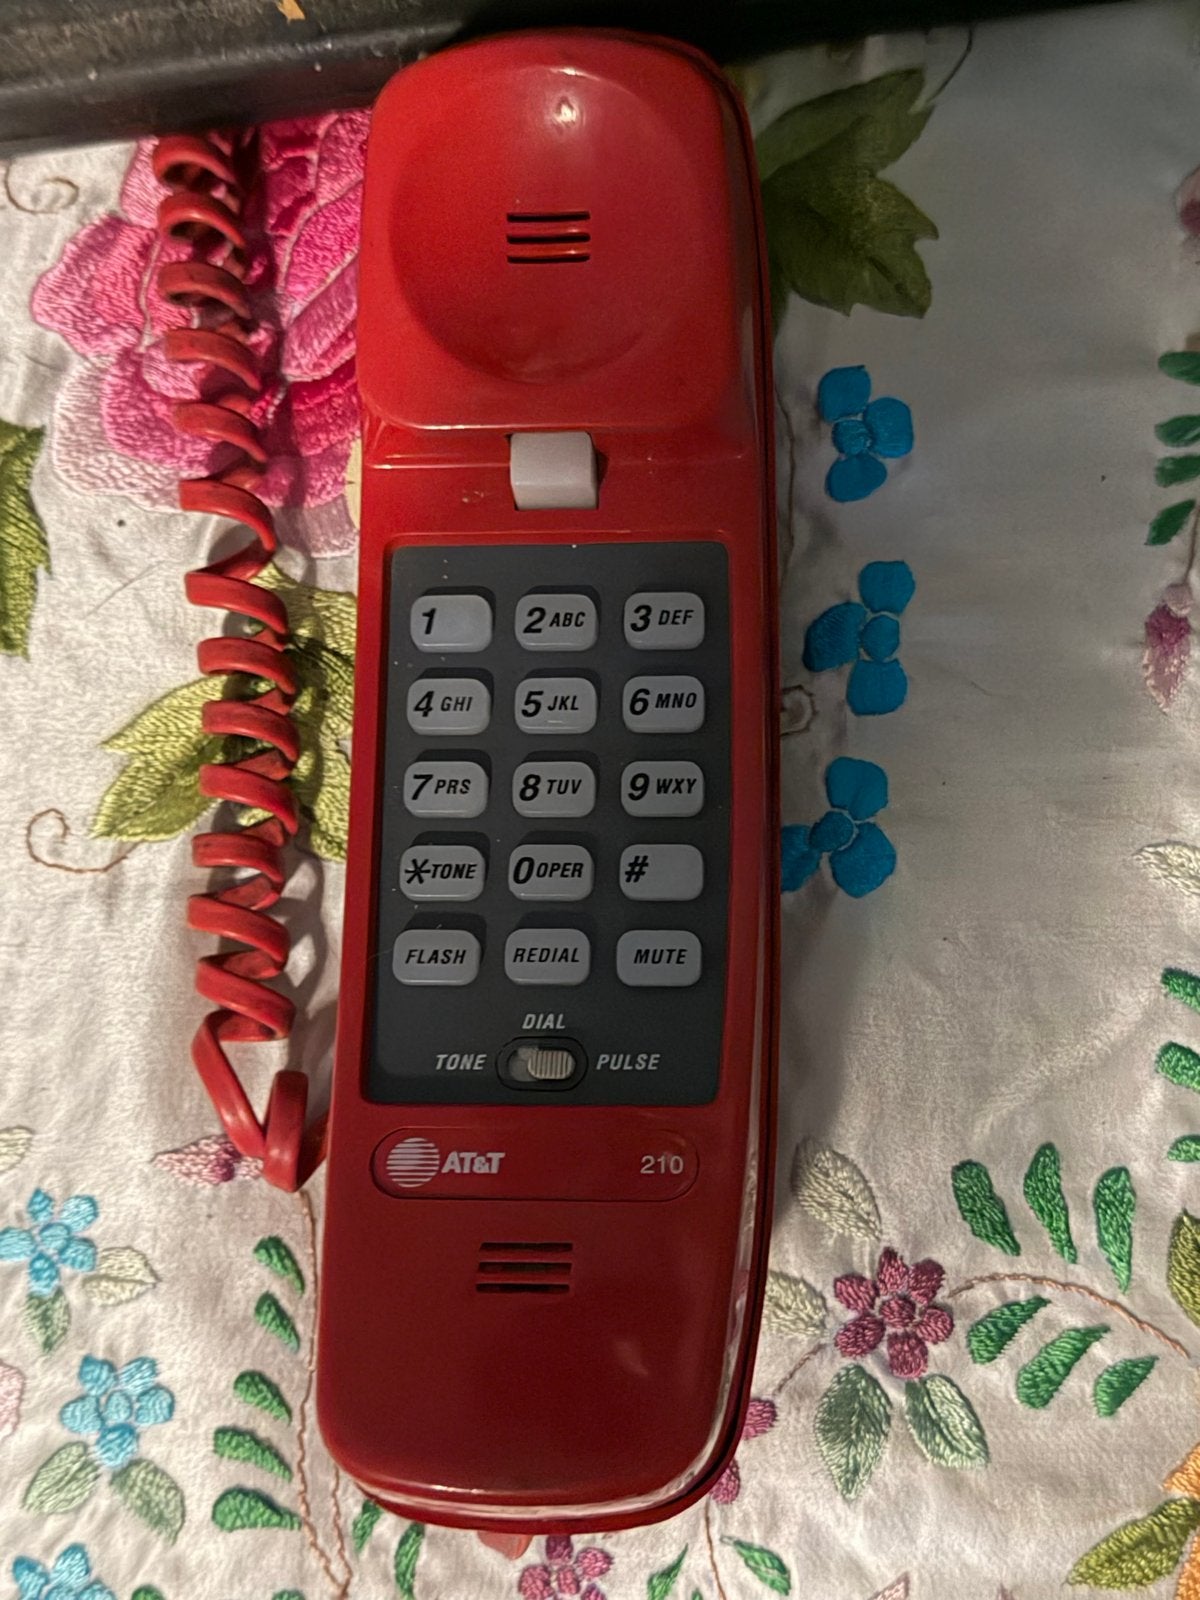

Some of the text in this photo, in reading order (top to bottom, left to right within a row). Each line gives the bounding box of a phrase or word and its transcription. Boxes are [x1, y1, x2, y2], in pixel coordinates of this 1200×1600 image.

[422, 608, 436, 634] 1
[523, 607, 586, 633] 2 ABC
[630, 605, 694, 632] 3 DEF
[413, 691, 473, 717] 4 GHI
[521, 691, 579, 717] 5 JKL
[629, 688, 697, 715] 6 MNO
[412, 774, 471, 800] 7 PRS
[519, 774, 582, 801] 8 TUV
[628, 773, 697, 800] 9 WXY
[513, 857, 584, 884] 0 OPER
[625, 855, 649, 882] #
[405, 949, 466, 965] FLASH
[513, 947, 580, 963] REDIAL
[633, 949, 687, 964] MUTE
[522, 1013, 566, 1030] DIAL
[436, 1054, 487, 1070] TONE
[596, 1054, 660, 1071] PULSE
[441, 1152, 505, 1174] AT&T
[640, 1155, 684, 1174] 210
